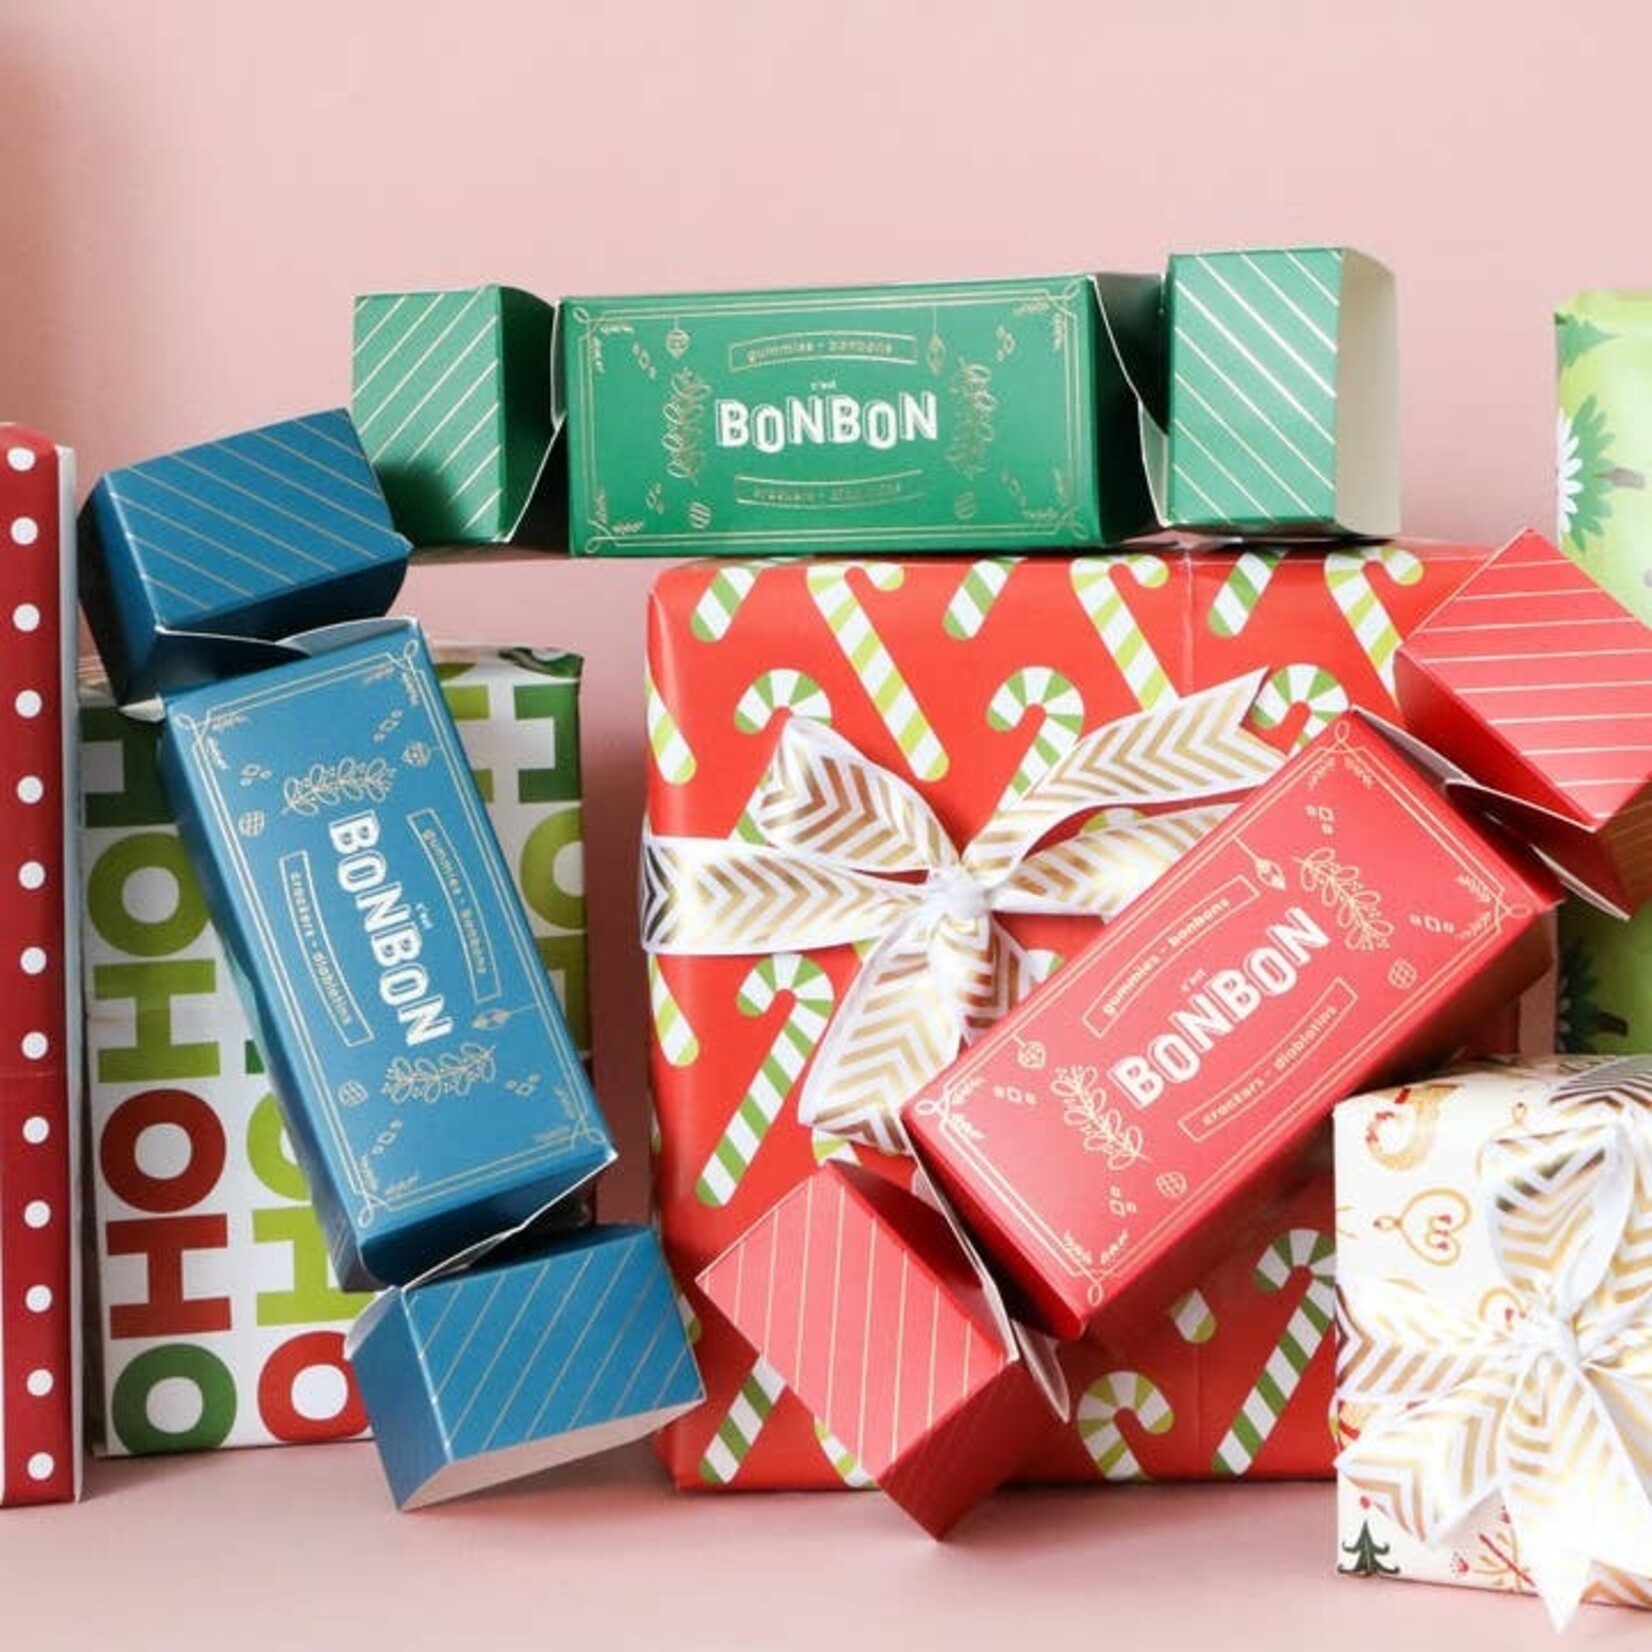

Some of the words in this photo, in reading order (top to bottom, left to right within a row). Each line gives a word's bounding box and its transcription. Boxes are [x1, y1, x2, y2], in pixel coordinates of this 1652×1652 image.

[715, 390, 938, 454] BONBON
[328, 809, 455, 1046] BONBON
[1103, 955, 1161, 1016] gummies
[1167, 898, 1231, 948] bonbons
[1107, 905, 1331, 1111] BONBON
